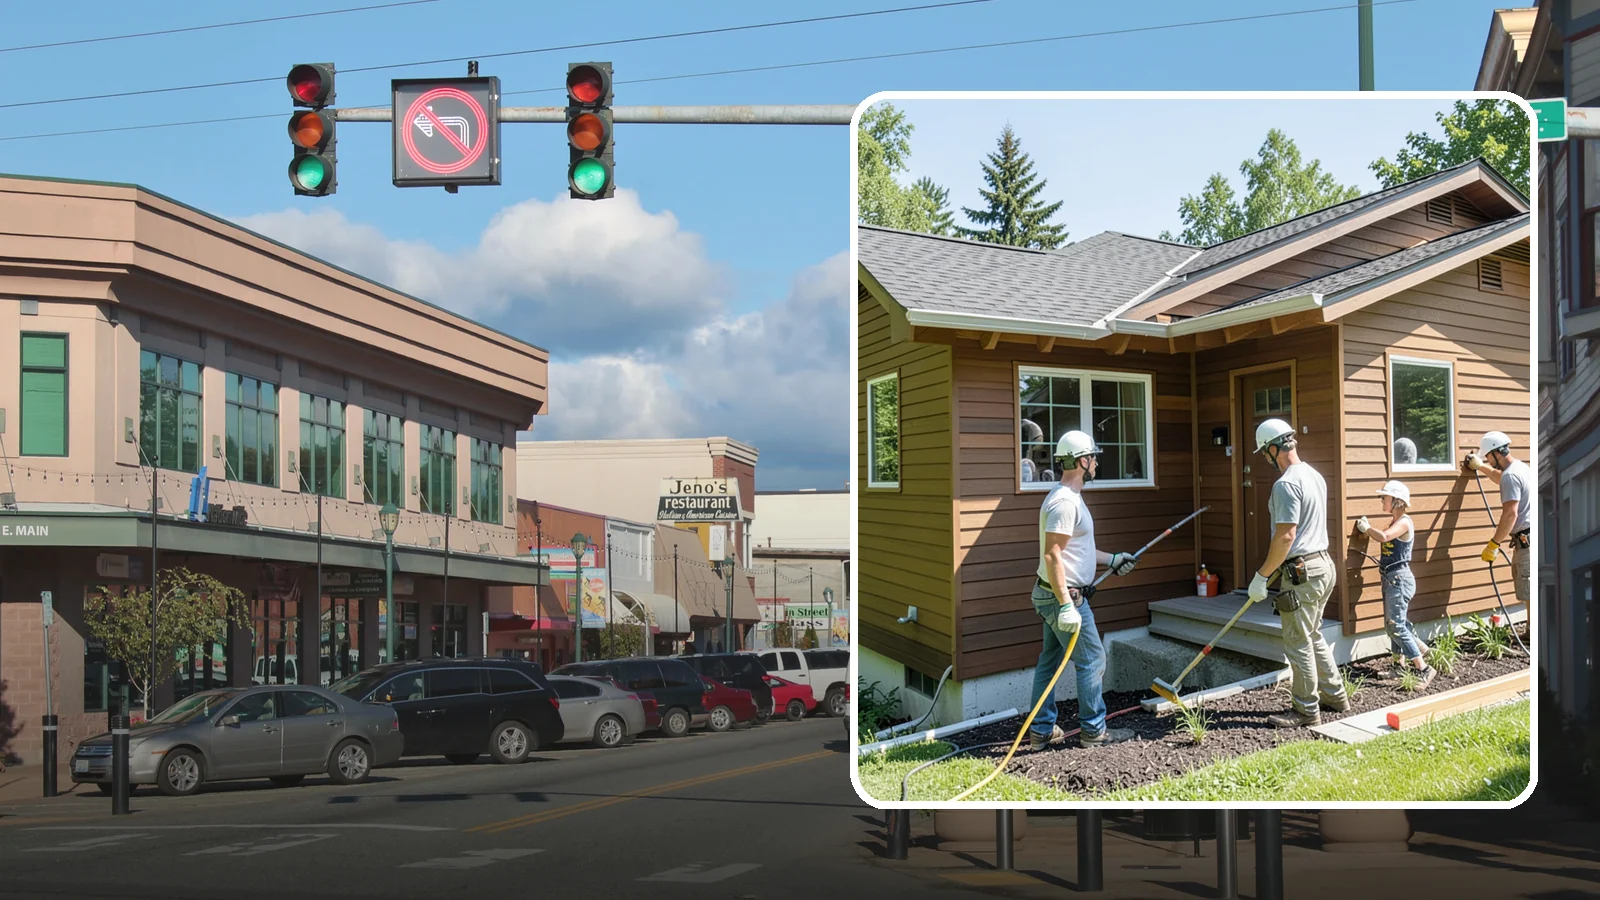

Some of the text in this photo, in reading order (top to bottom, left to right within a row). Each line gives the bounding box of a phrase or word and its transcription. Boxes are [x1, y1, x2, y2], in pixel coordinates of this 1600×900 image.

[669, 480, 727, 494] Jeno's
[665, 496, 731, 509] restaurant
[658, 510, 681, 519] Italian
[686, 510, 714, 519] American
[715, 509, 738, 519] Cuisine
[2, 525, 49, 536] E. MAIN
[797, 607, 829, 617] Street
